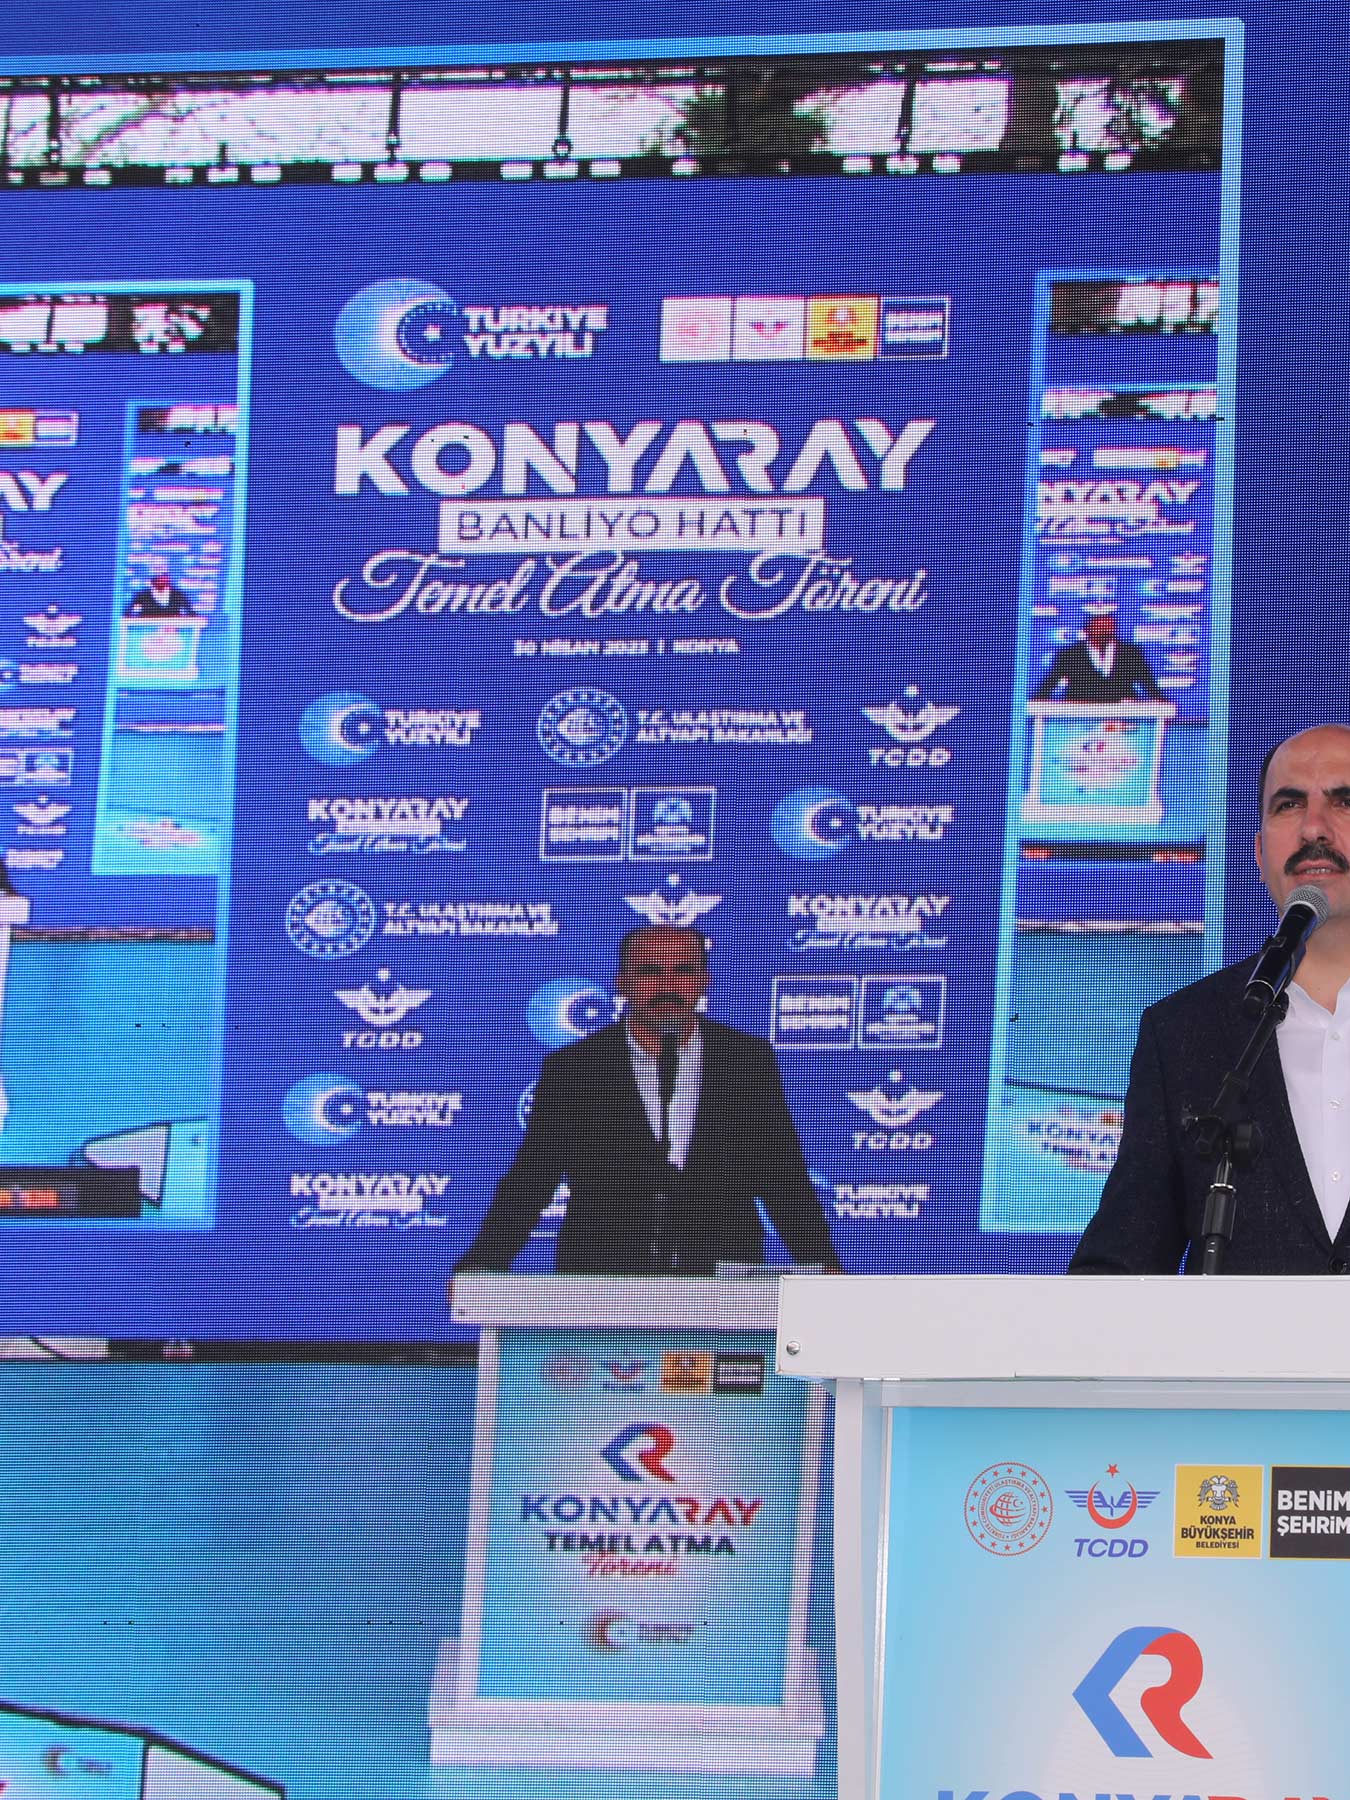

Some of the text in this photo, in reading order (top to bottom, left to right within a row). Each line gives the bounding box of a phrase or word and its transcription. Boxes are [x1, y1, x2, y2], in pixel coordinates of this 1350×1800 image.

[335, 419, 936, 495] KONYARAY
[458, 504, 807, 540] BANLİYÖ HATTI
[333, 550, 534, 622] Temel
[539, 549, 705, 618] Atma
[514, 640, 537, 655] 30
[673, 639, 740, 654] KONYA
[521, 1495, 762, 1526] KONYARAY
[1200, 1515, 1236, 1525] KONYA
[1181, 1525, 1254, 1541] BÜYÜKŞEHİR
[1277, 1515, 1350, 1536] ŞEHRİM
[545, 1531, 735, 1556] TEMEL ATMA
[1074, 1538, 1148, 1558] TCDD
[1196, 1541, 1239, 1549] BELEDİYESİ
